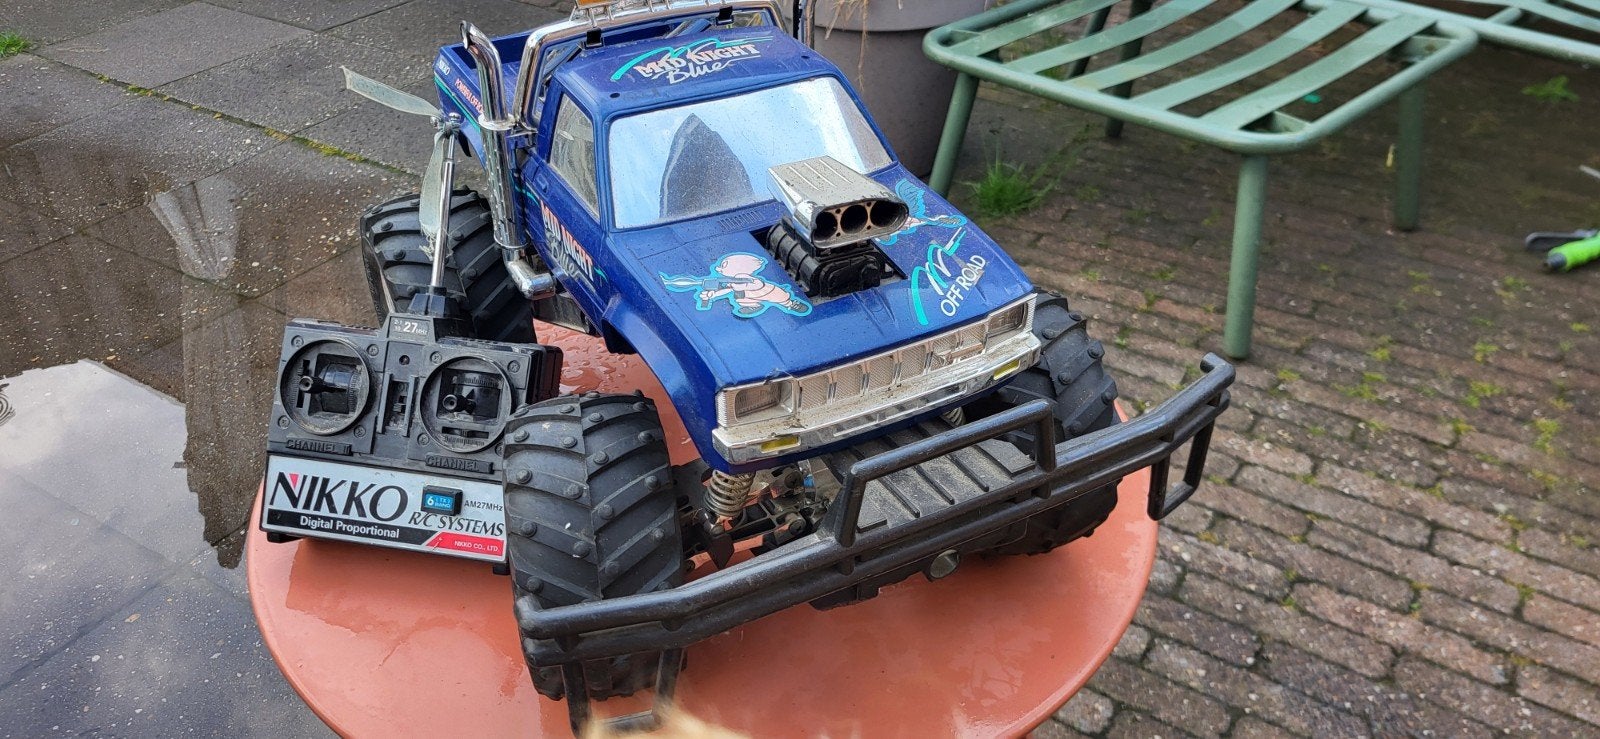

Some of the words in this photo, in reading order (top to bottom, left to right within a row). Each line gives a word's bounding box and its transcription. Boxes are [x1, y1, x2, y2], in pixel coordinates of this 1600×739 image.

[634, 52, 687, 77] MID
[686, 44, 760, 65] NIGHT
[658, 59, 738, 84] Blue
[540, 199, 562, 242] MID
[560, 224, 594, 281] NIGHT
[940, 284, 964, 317] OFF
[955, 254, 986, 291] ROAD
[287, 439, 336, 454] CHANNEL
[425, 456, 481, 472] CHANNEL
[269, 471, 409, 522] NIKKO
[427, 495, 435, 506] 6
[464, 500, 503, 512] AM27MHz
[300, 515, 333, 530] Digital
[336, 520, 400, 538] Proportional
[408, 511, 438, 528] R/C
[437, 515, 505, 537] SYSTEMS
[454, 540, 473, 548] NIKKO
